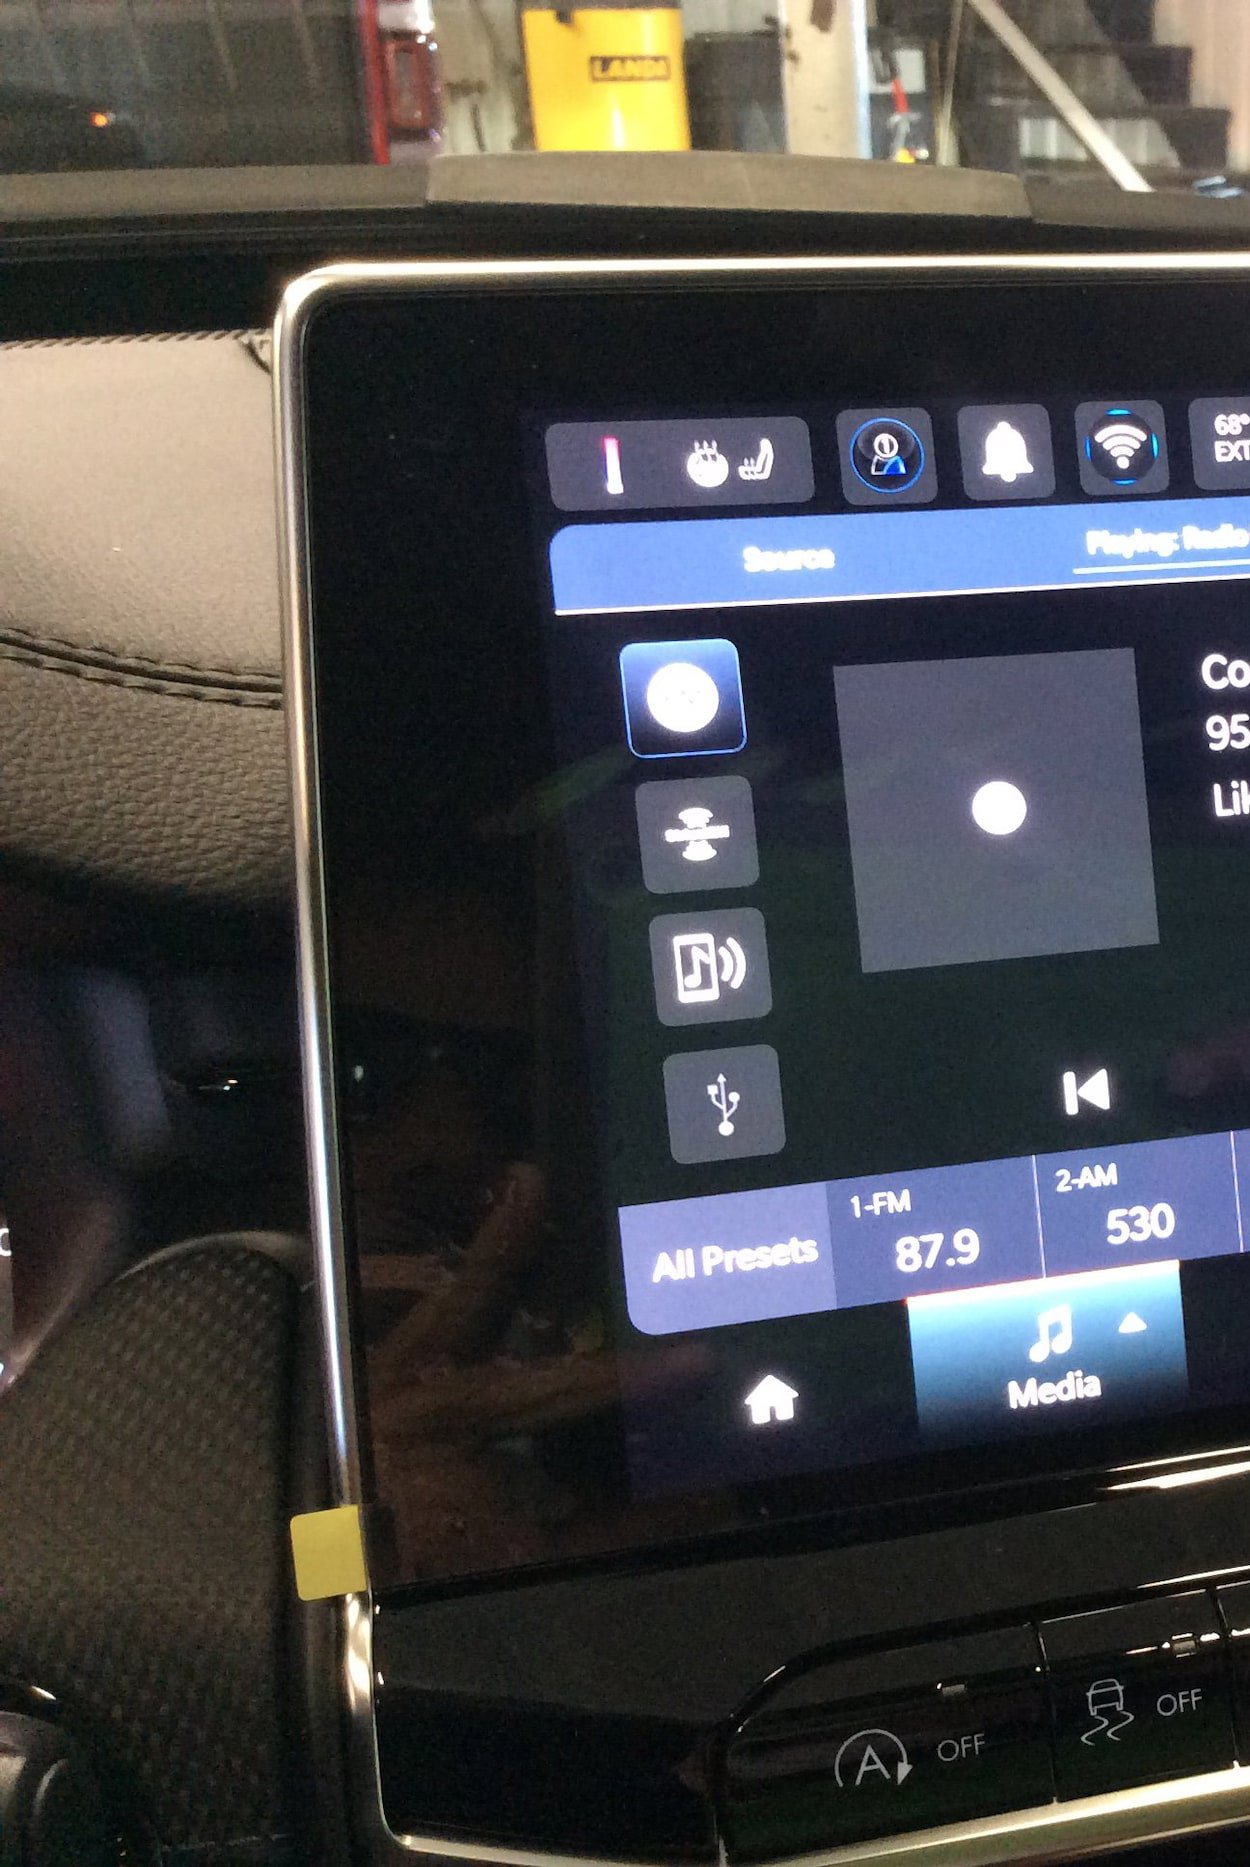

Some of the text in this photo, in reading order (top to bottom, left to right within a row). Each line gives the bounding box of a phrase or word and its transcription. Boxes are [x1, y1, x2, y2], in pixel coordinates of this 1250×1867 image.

[1181, 523, 1250, 550] Radio
[742, 545, 836, 573] Source
[1055, 1162, 1118, 1193] 2-AM
[850, 1188, 912, 1218] 1-FM
[1106, 1202, 1176, 1245] 530
[652, 1236, 819, 1284] All Presets
[895, 1228, 980, 1273] 87.9
[1007, 1369, 1102, 1410] Media
[1156, 1688, 1203, 1717] OFF
[937, 1733, 985, 1762] OFF
